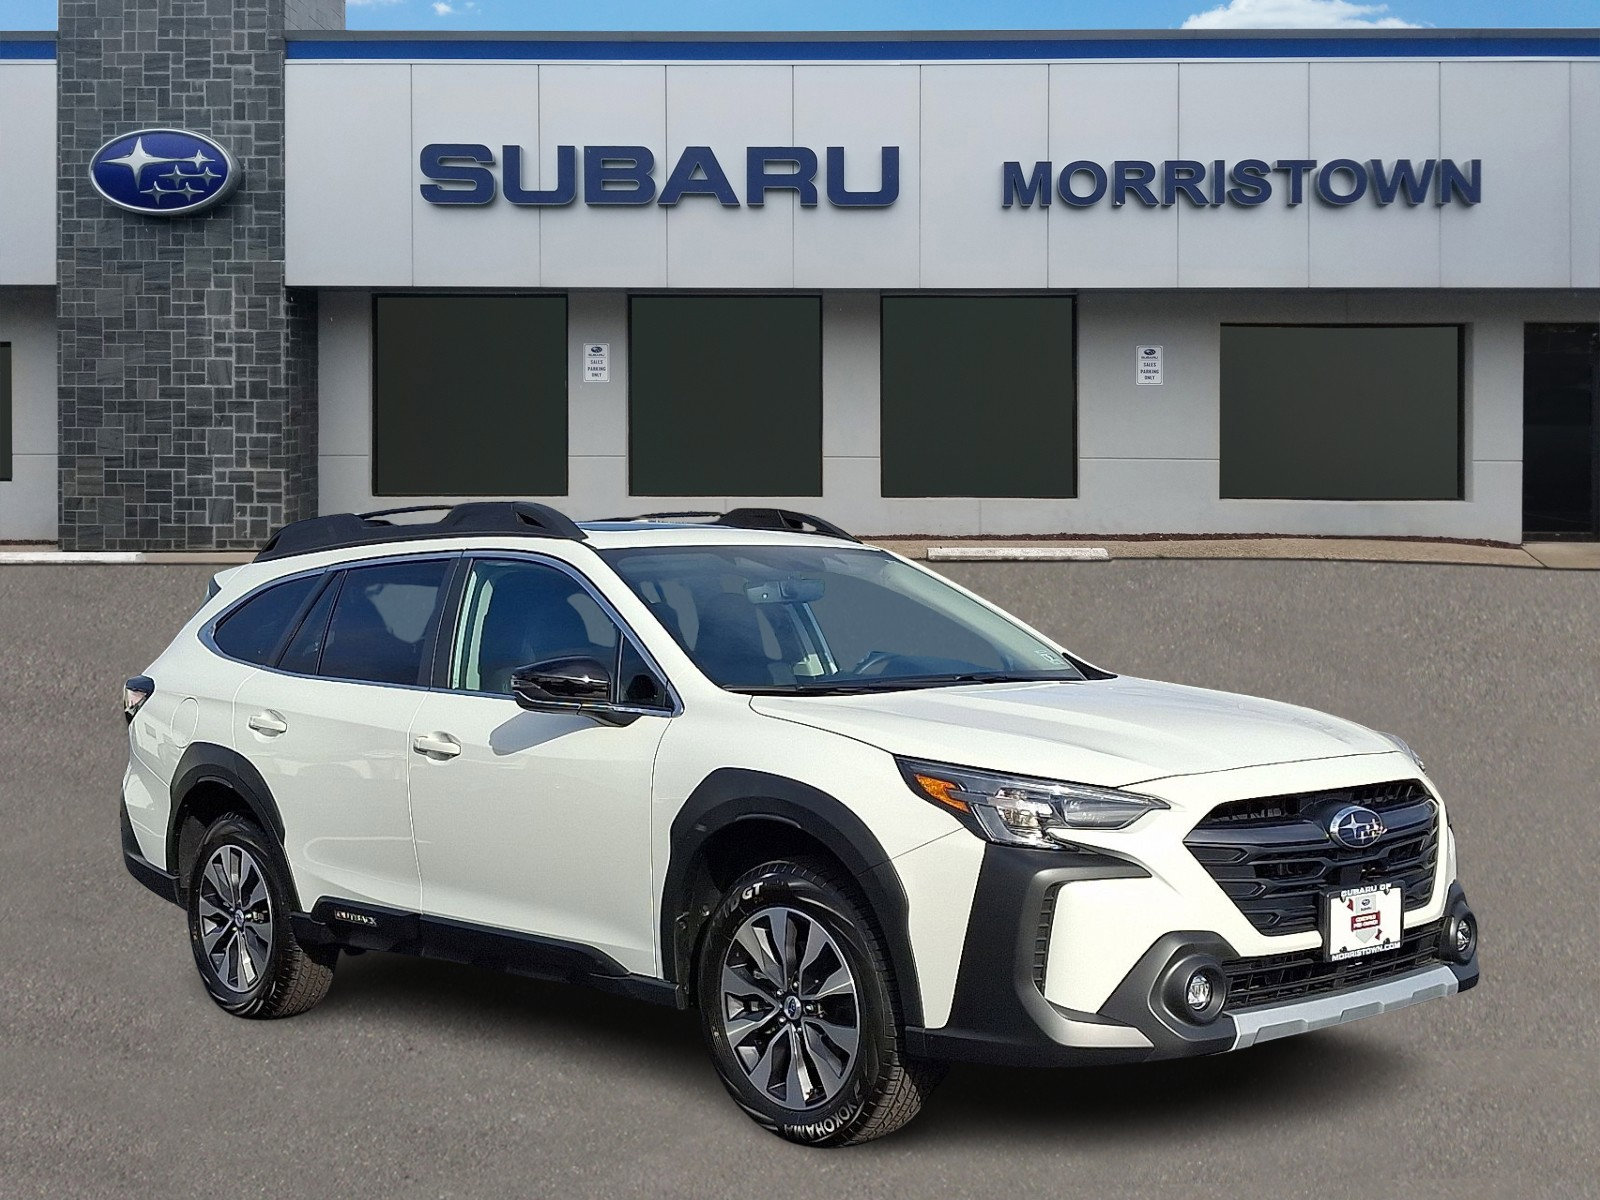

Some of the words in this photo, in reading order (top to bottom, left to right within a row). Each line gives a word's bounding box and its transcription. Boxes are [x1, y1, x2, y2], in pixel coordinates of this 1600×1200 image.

[420, 143, 899, 208] SUBARU
[1001, 158, 1482, 208] MORRISTOWN
[742, 881, 763, 900] GT
[1340, 885, 1377, 897] SUBARU
[1331, 942, 1400, 961] MORRISTOWN.COM
